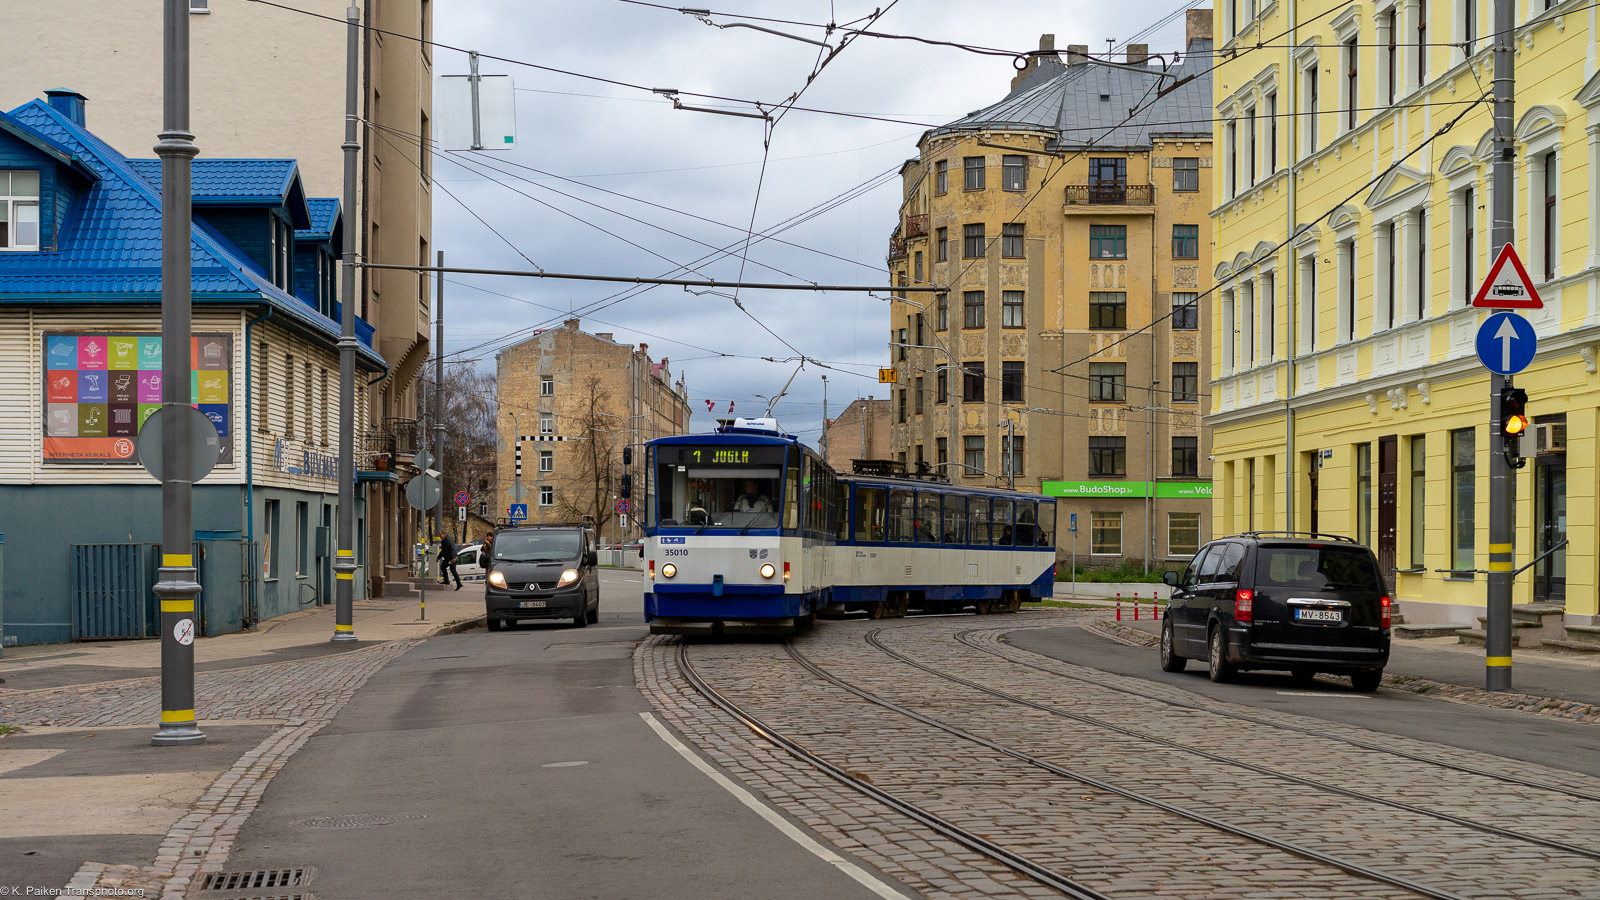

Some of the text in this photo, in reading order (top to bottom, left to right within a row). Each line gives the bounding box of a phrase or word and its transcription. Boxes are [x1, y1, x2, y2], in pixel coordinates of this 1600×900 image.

[693, 450, 749, 463] 1 JUGLA
[1063, 485, 1133, 495] www.BudoShop.lv
[1301, 610, 1340, 620] MV-8543
